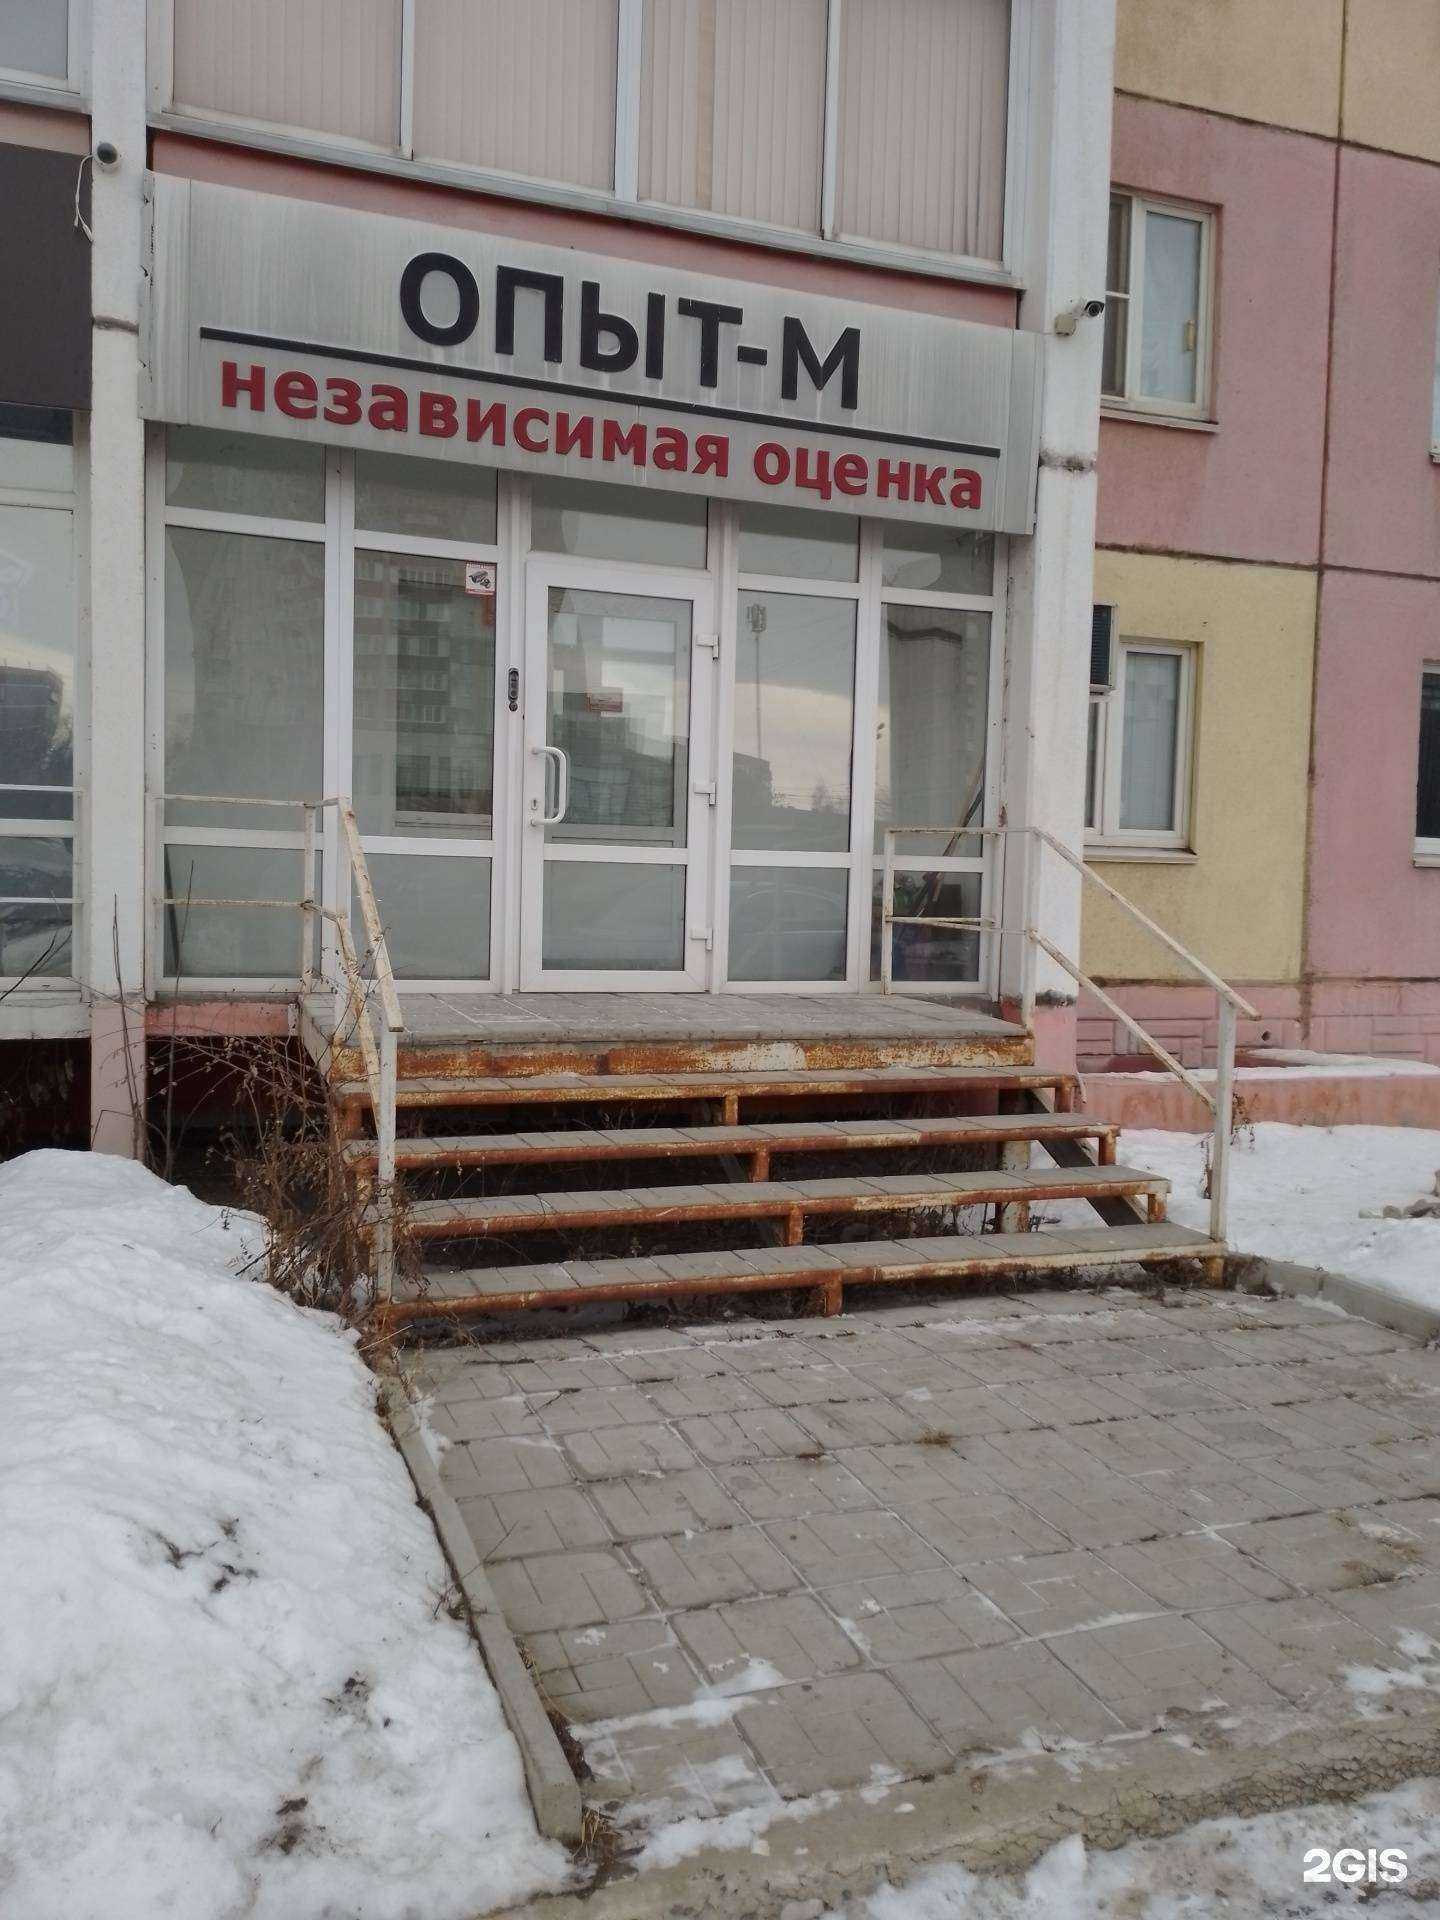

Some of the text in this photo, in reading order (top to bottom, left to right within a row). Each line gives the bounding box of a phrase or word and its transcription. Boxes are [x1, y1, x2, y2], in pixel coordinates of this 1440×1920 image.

[400, 252, 861, 410] ОПЫТ-М
[221, 361, 983, 509] независимая оценка
